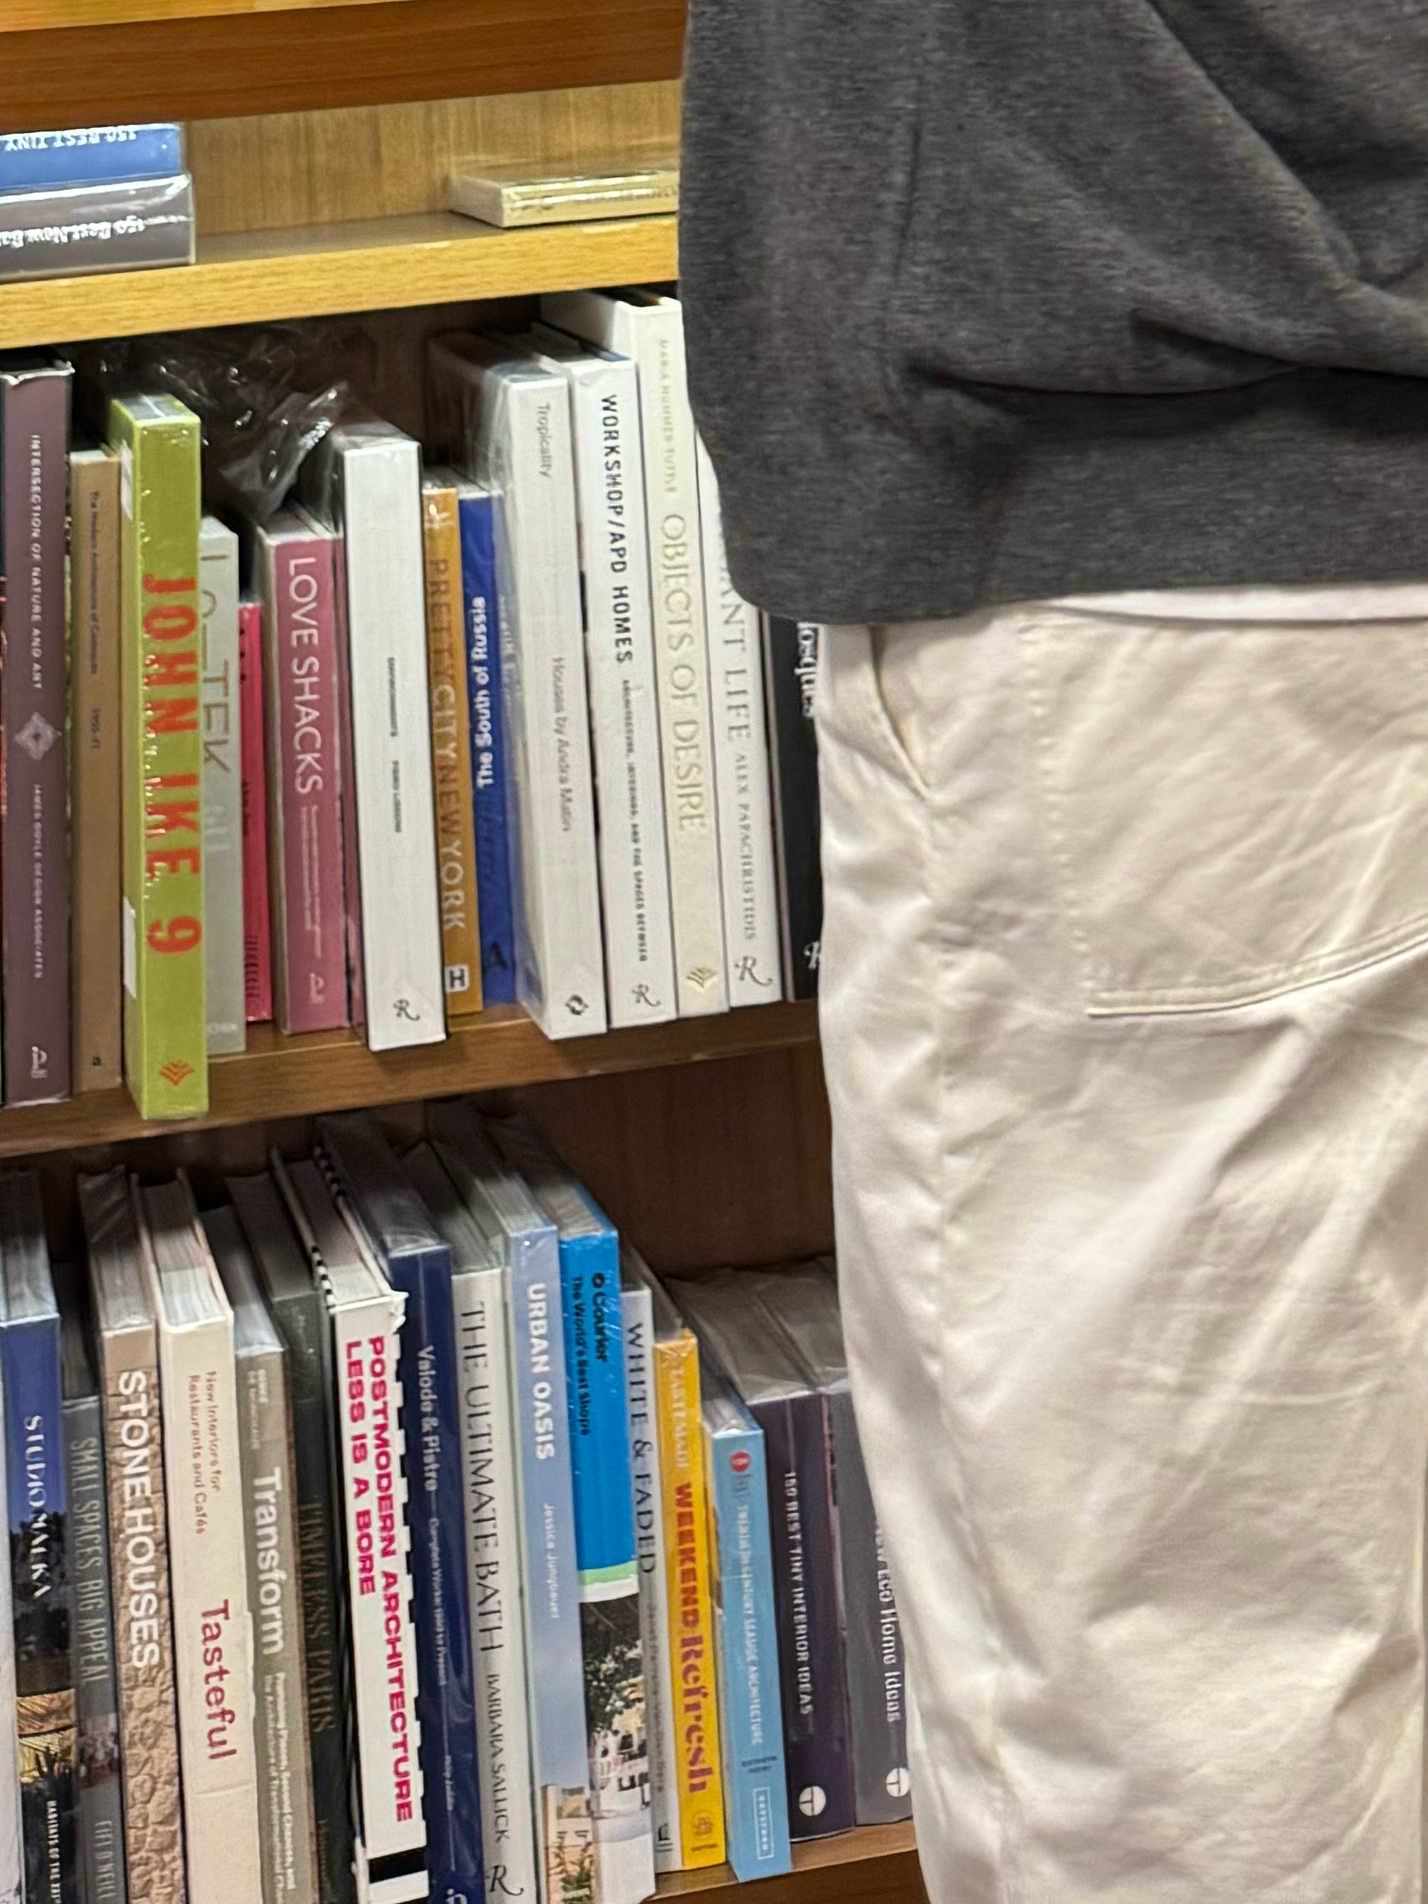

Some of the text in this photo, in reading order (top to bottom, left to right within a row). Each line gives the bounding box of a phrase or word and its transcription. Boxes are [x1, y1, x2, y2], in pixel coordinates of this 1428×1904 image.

[288, 556, 320, 647] LOVE
[141, 575, 204, 955] JOHN IKE 9
[290, 655, 323, 794] SHACKS
[526, 1283, 556, 1460] URBAN OASIS
[118, 1370, 160, 1669] STONE HOUSES
[252, 1468, 284, 1655] Transform
[368, 1335, 413, 1823] POSTMODERN ARCHITECTURE
[200, 1599, 237, 1761] Tasteful
